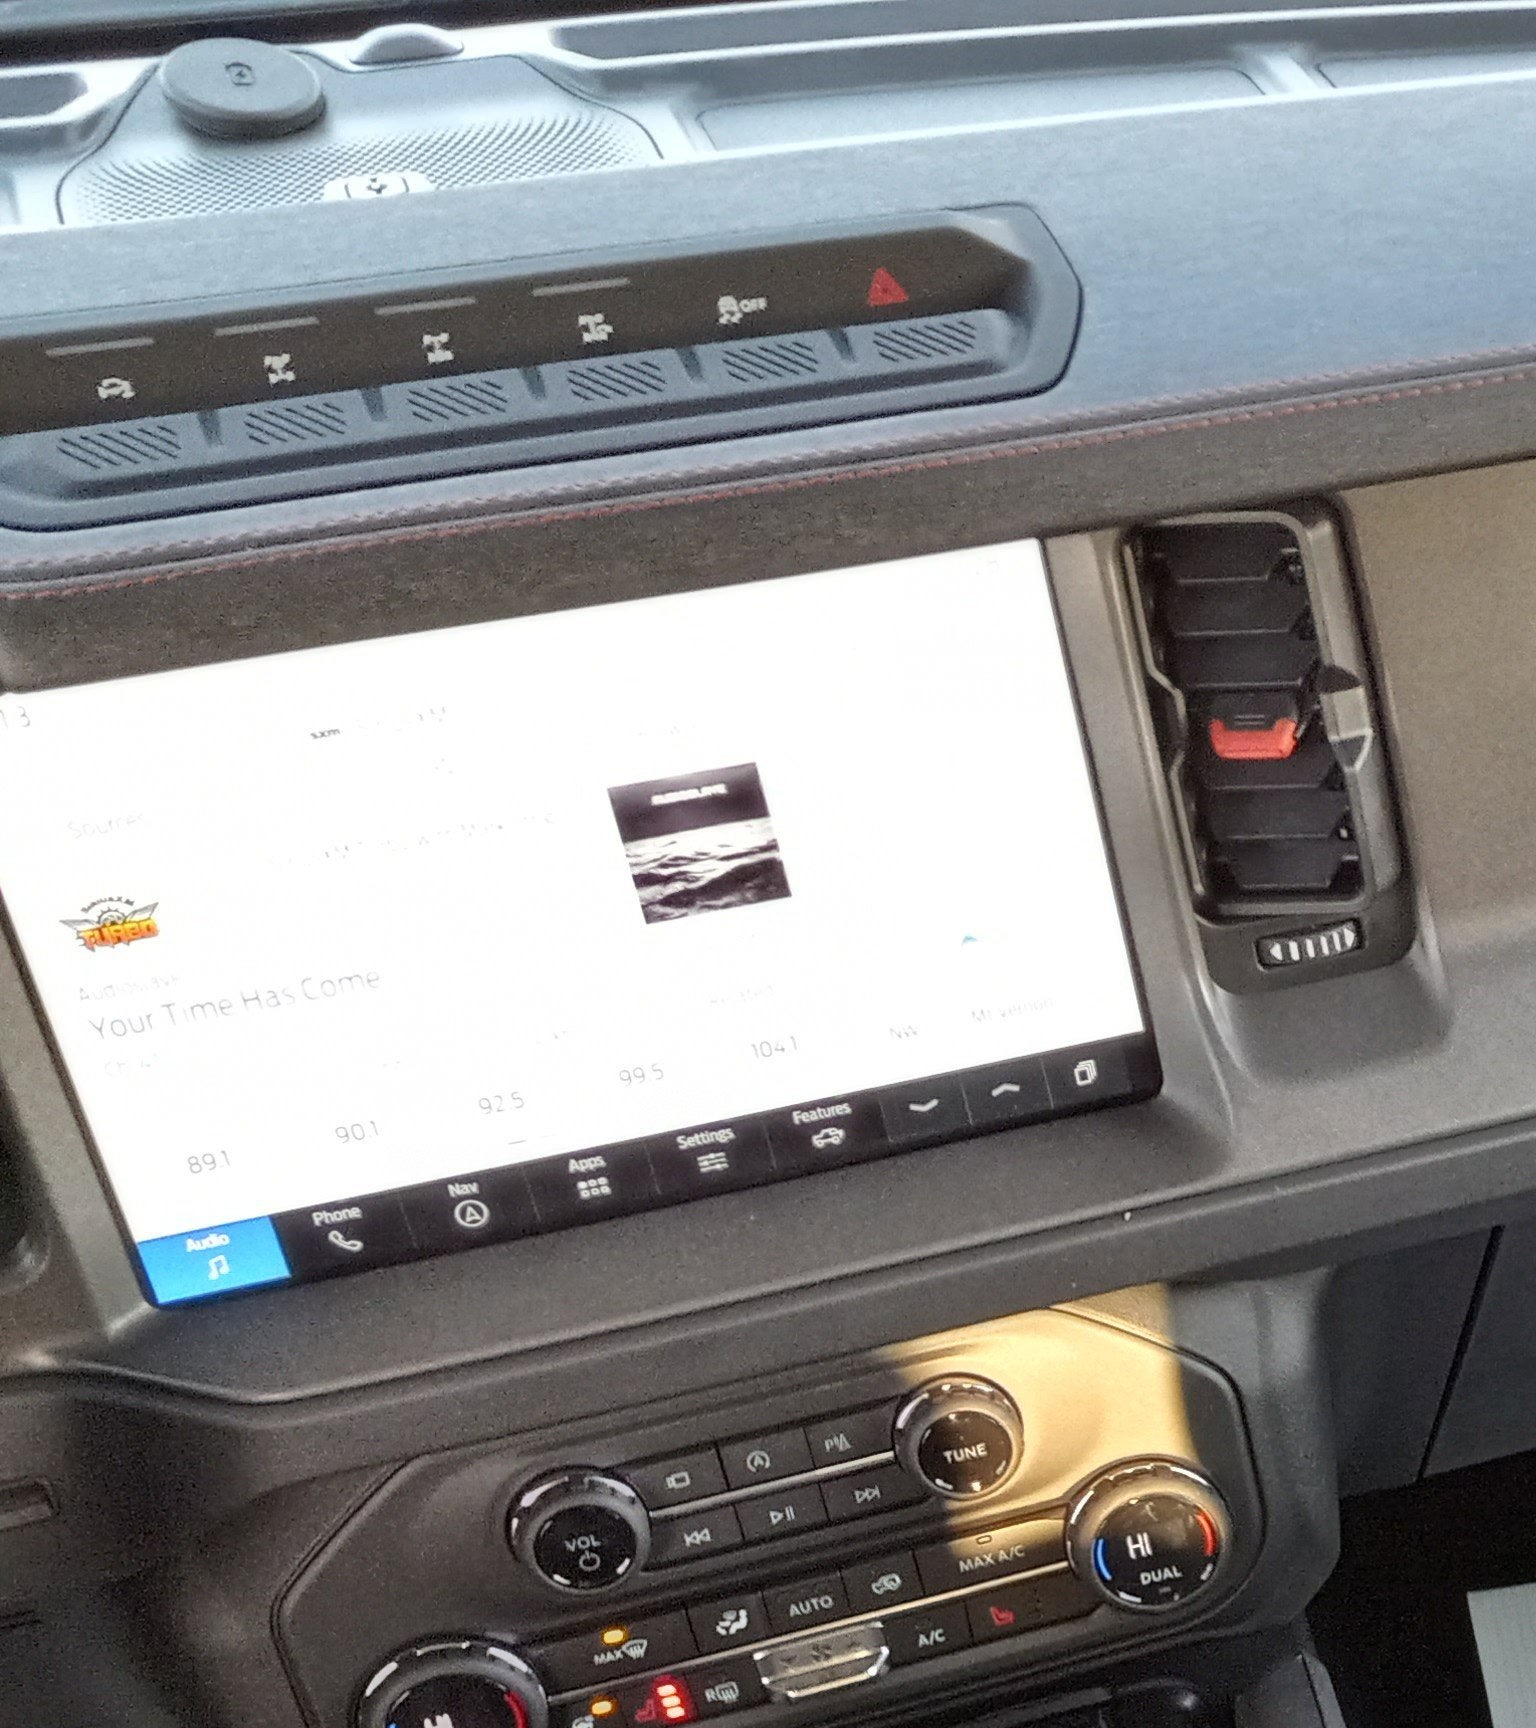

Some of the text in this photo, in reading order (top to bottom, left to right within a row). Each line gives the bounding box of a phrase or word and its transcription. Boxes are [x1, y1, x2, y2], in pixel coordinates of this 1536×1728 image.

[88, 970, 381, 1040] Your Time Has Come
[792, 1103, 852, 1125] Features
[676, 1128, 736, 1151] Settings
[568, 1155, 607, 1175] Apps
[448, 1182, 480, 1198] Nav
[312, 1206, 363, 1227] Phone
[186, 1232, 230, 1253] Audio
[943, 1443, 988, 1466] TUNE
[564, 1534, 601, 1551] VOL
[1125, 1532, 1153, 1559] HI
[958, 1544, 1026, 1574] MAX A/C
[1140, 1564, 1183, 1587] DUAL
[788, 1595, 833, 1617] AUTO
[918, 1628, 947, 1648] A/C
[594, 1648, 622, 1666] MAX
